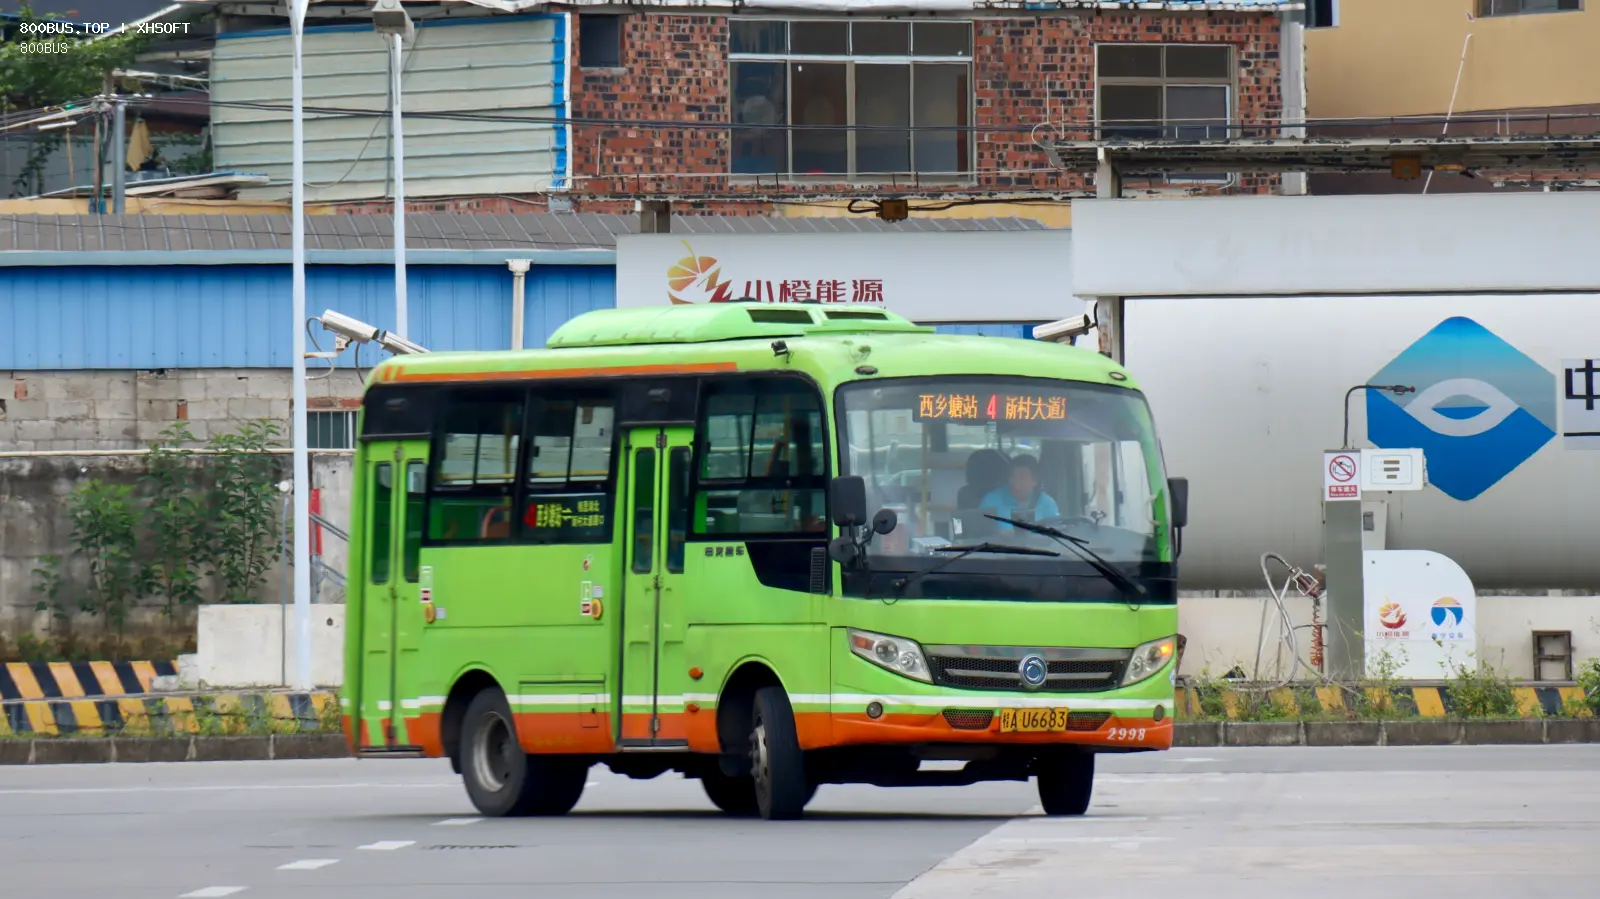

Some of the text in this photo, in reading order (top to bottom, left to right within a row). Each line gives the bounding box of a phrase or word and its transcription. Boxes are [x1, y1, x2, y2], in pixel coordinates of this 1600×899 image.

[744, 279, 883, 303] 小橙能源
[1565, 359, 1600, 410] 中
[919, 395, 978, 418] 西乡塘站
[987, 395, 997, 419] 4
[1107, 728, 1146, 740] 2998
